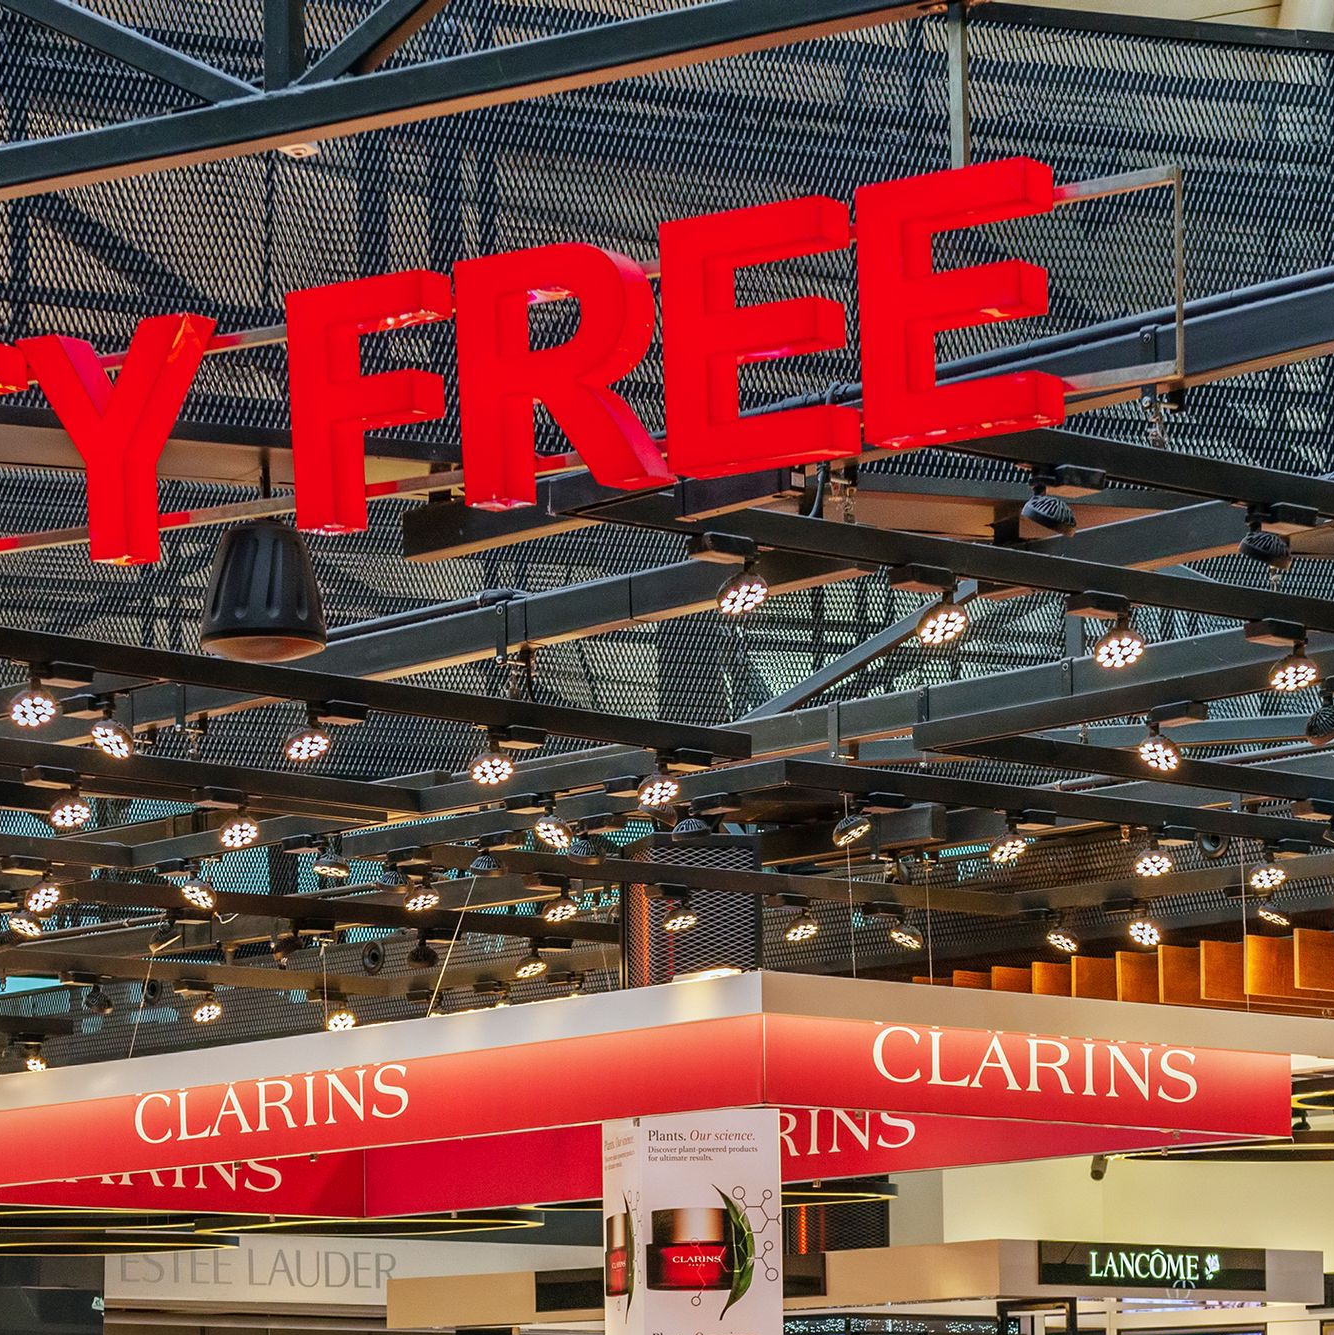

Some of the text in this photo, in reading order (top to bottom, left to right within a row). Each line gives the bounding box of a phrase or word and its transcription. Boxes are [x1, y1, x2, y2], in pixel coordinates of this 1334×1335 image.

[284, 155, 1066, 535] FREE
[871, 1025, 1199, 1104] CLARINS
[134, 1064, 409, 1144] CLARINS
[648, 1129, 756, 1142] Plants. Our science.
[648, 1145, 759, 1155] Discover plant-powered products
[780, 1108, 917, 1158] RINS
[648, 1153, 714, 1163] for ultimate results.
[248, 1248, 397, 1290] LAUDER
[672, 1254, 722, 1264] CLARINS
[1089, 1248, 1200, 1280] LANCÔME
